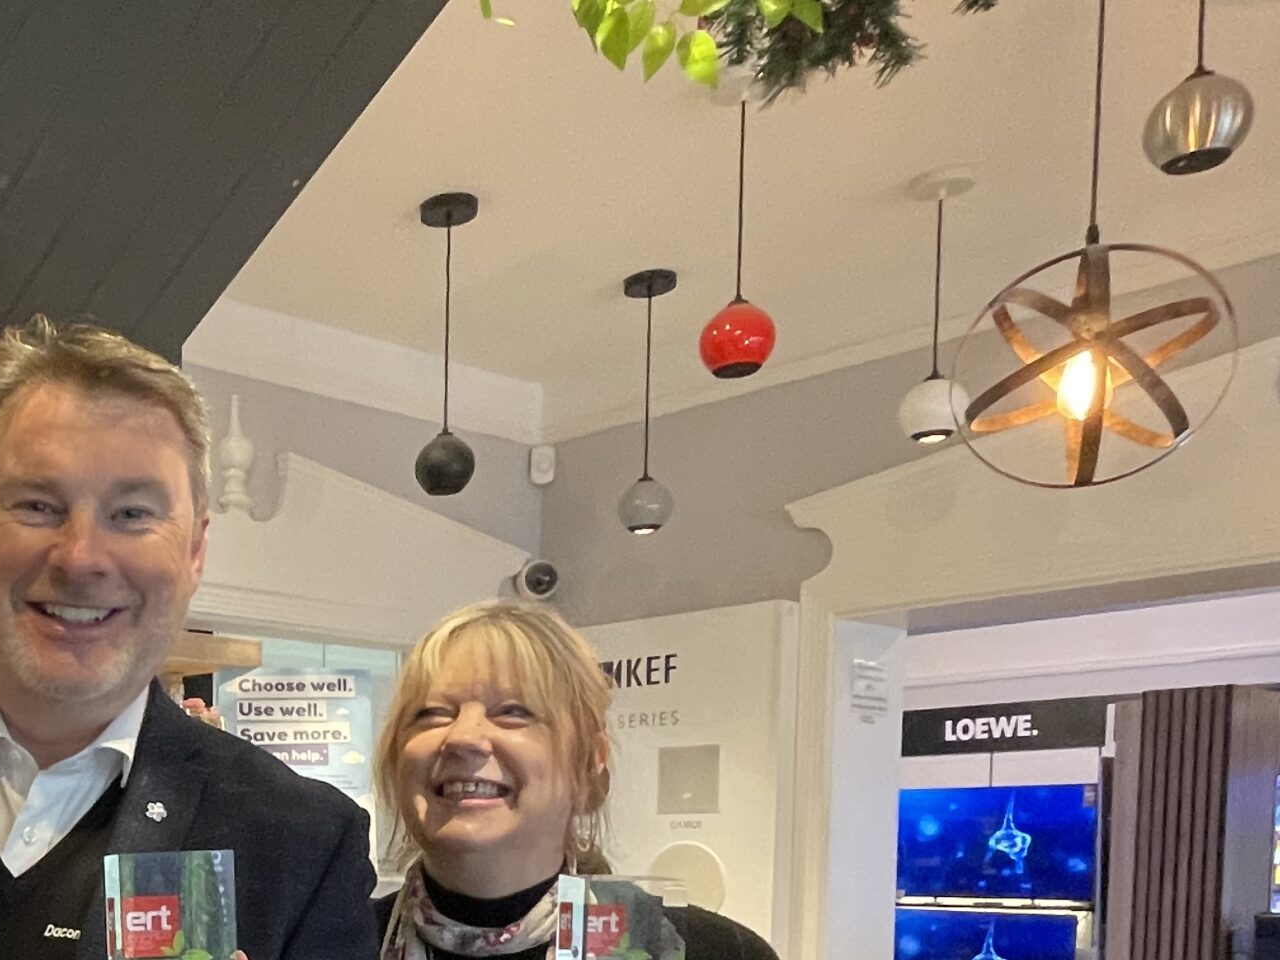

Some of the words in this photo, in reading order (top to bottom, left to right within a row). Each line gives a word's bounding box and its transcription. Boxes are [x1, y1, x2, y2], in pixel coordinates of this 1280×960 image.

[626, 653, 678, 688] KEF
[238, 678, 306, 693] Choose
[311, 678, 354, 693] well.
[238, 702, 275, 717] Use
[280, 702, 324, 717] well.
[617, 711, 680, 730] SERIES
[240, 728, 288, 743] Save
[293, 730, 348, 742] more.
[944, 714, 1039, 742] LOEWE.
[126, 905, 172, 931] ert
[586, 906, 619, 932] ert
